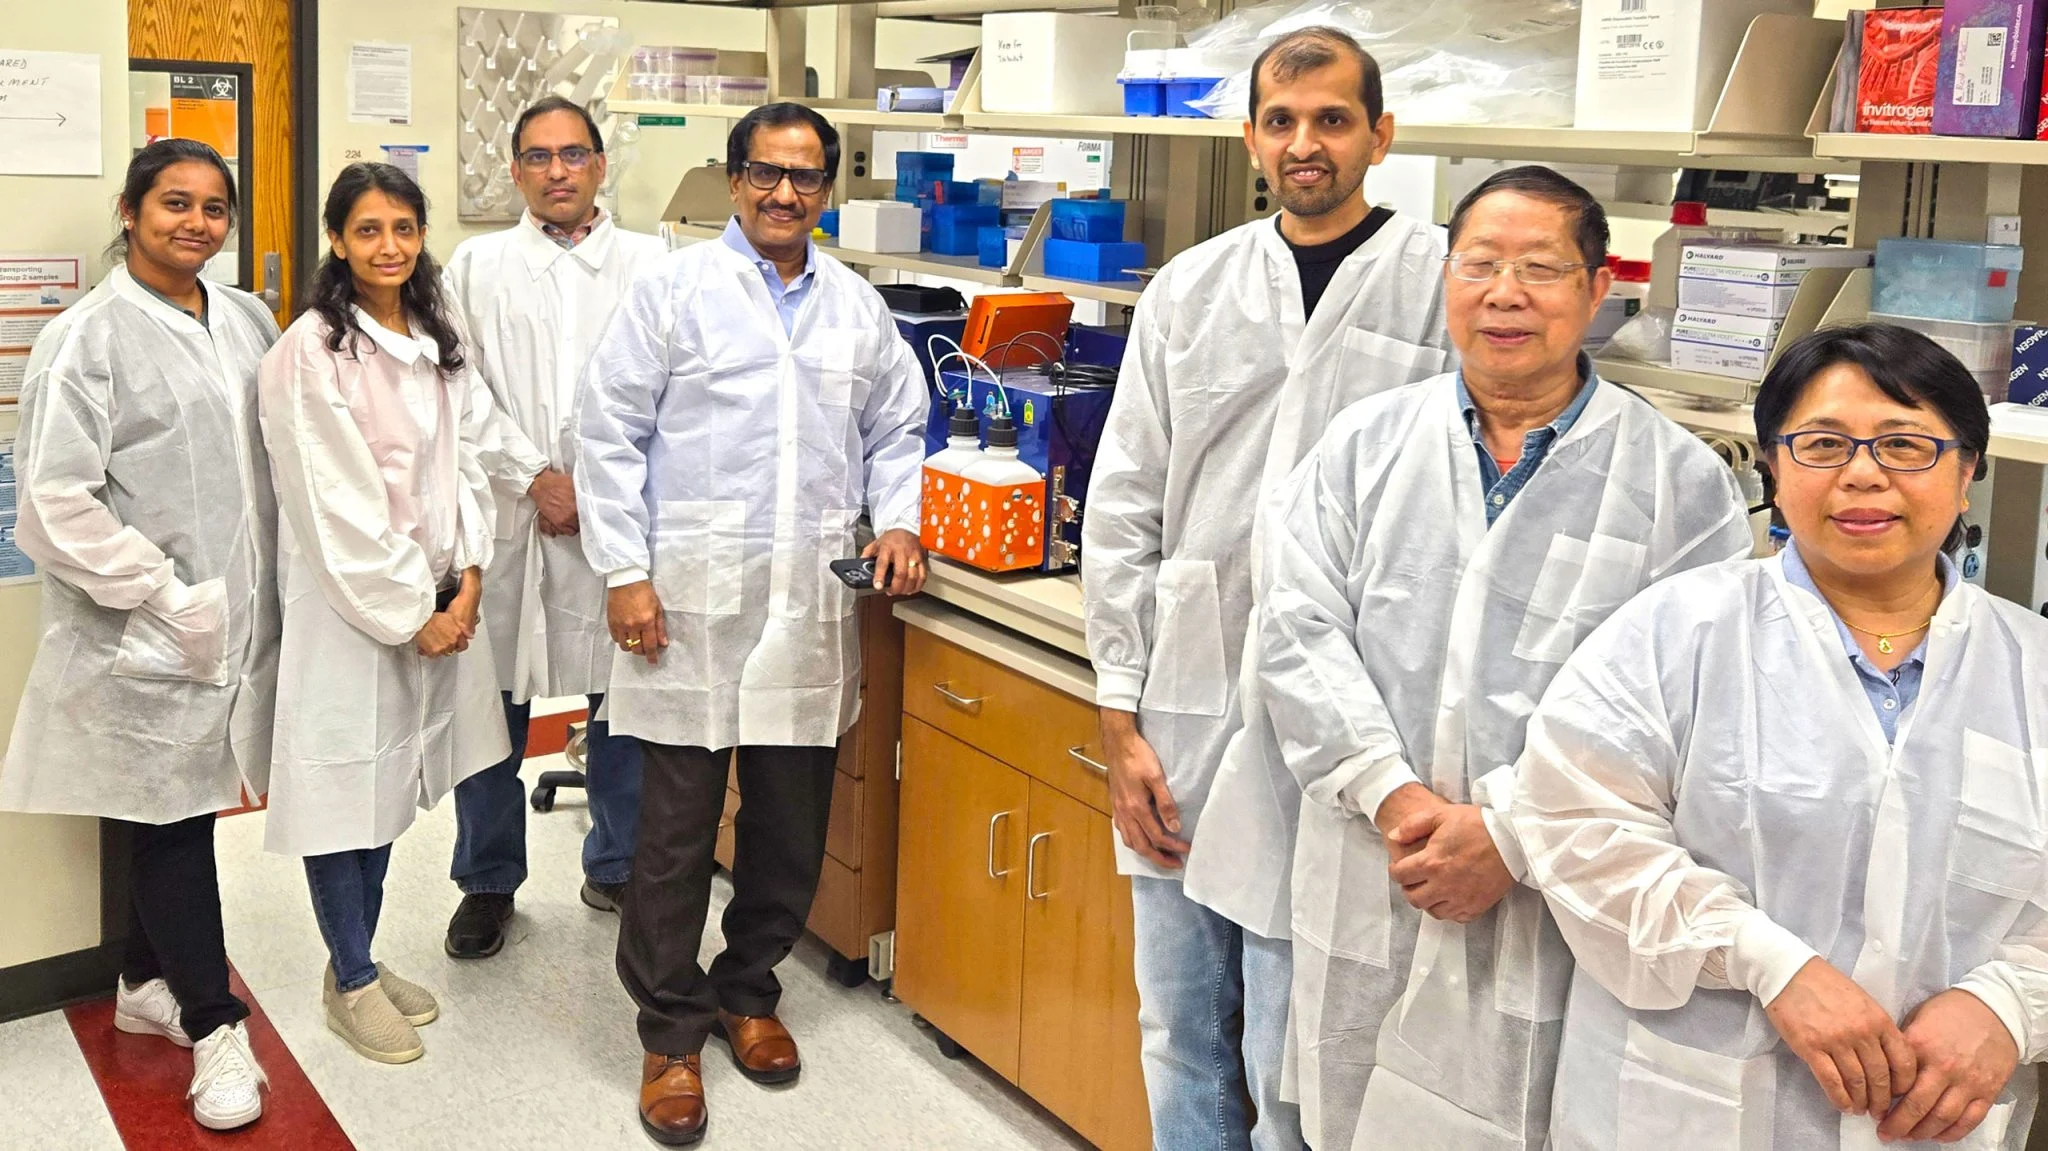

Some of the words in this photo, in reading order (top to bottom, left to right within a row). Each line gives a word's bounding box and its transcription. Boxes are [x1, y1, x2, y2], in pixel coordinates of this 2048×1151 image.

[173, 76, 186, 84] BL
[188, 76, 194, 84] 2
[1862, 100, 1934, 121] invitrogen
[1077, 141, 1101, 152] FORMA
[345, 150, 361, 159] 224
[1694, 252, 1724, 261] HALYARD
[1687, 316, 1717, 325] HALYARD
